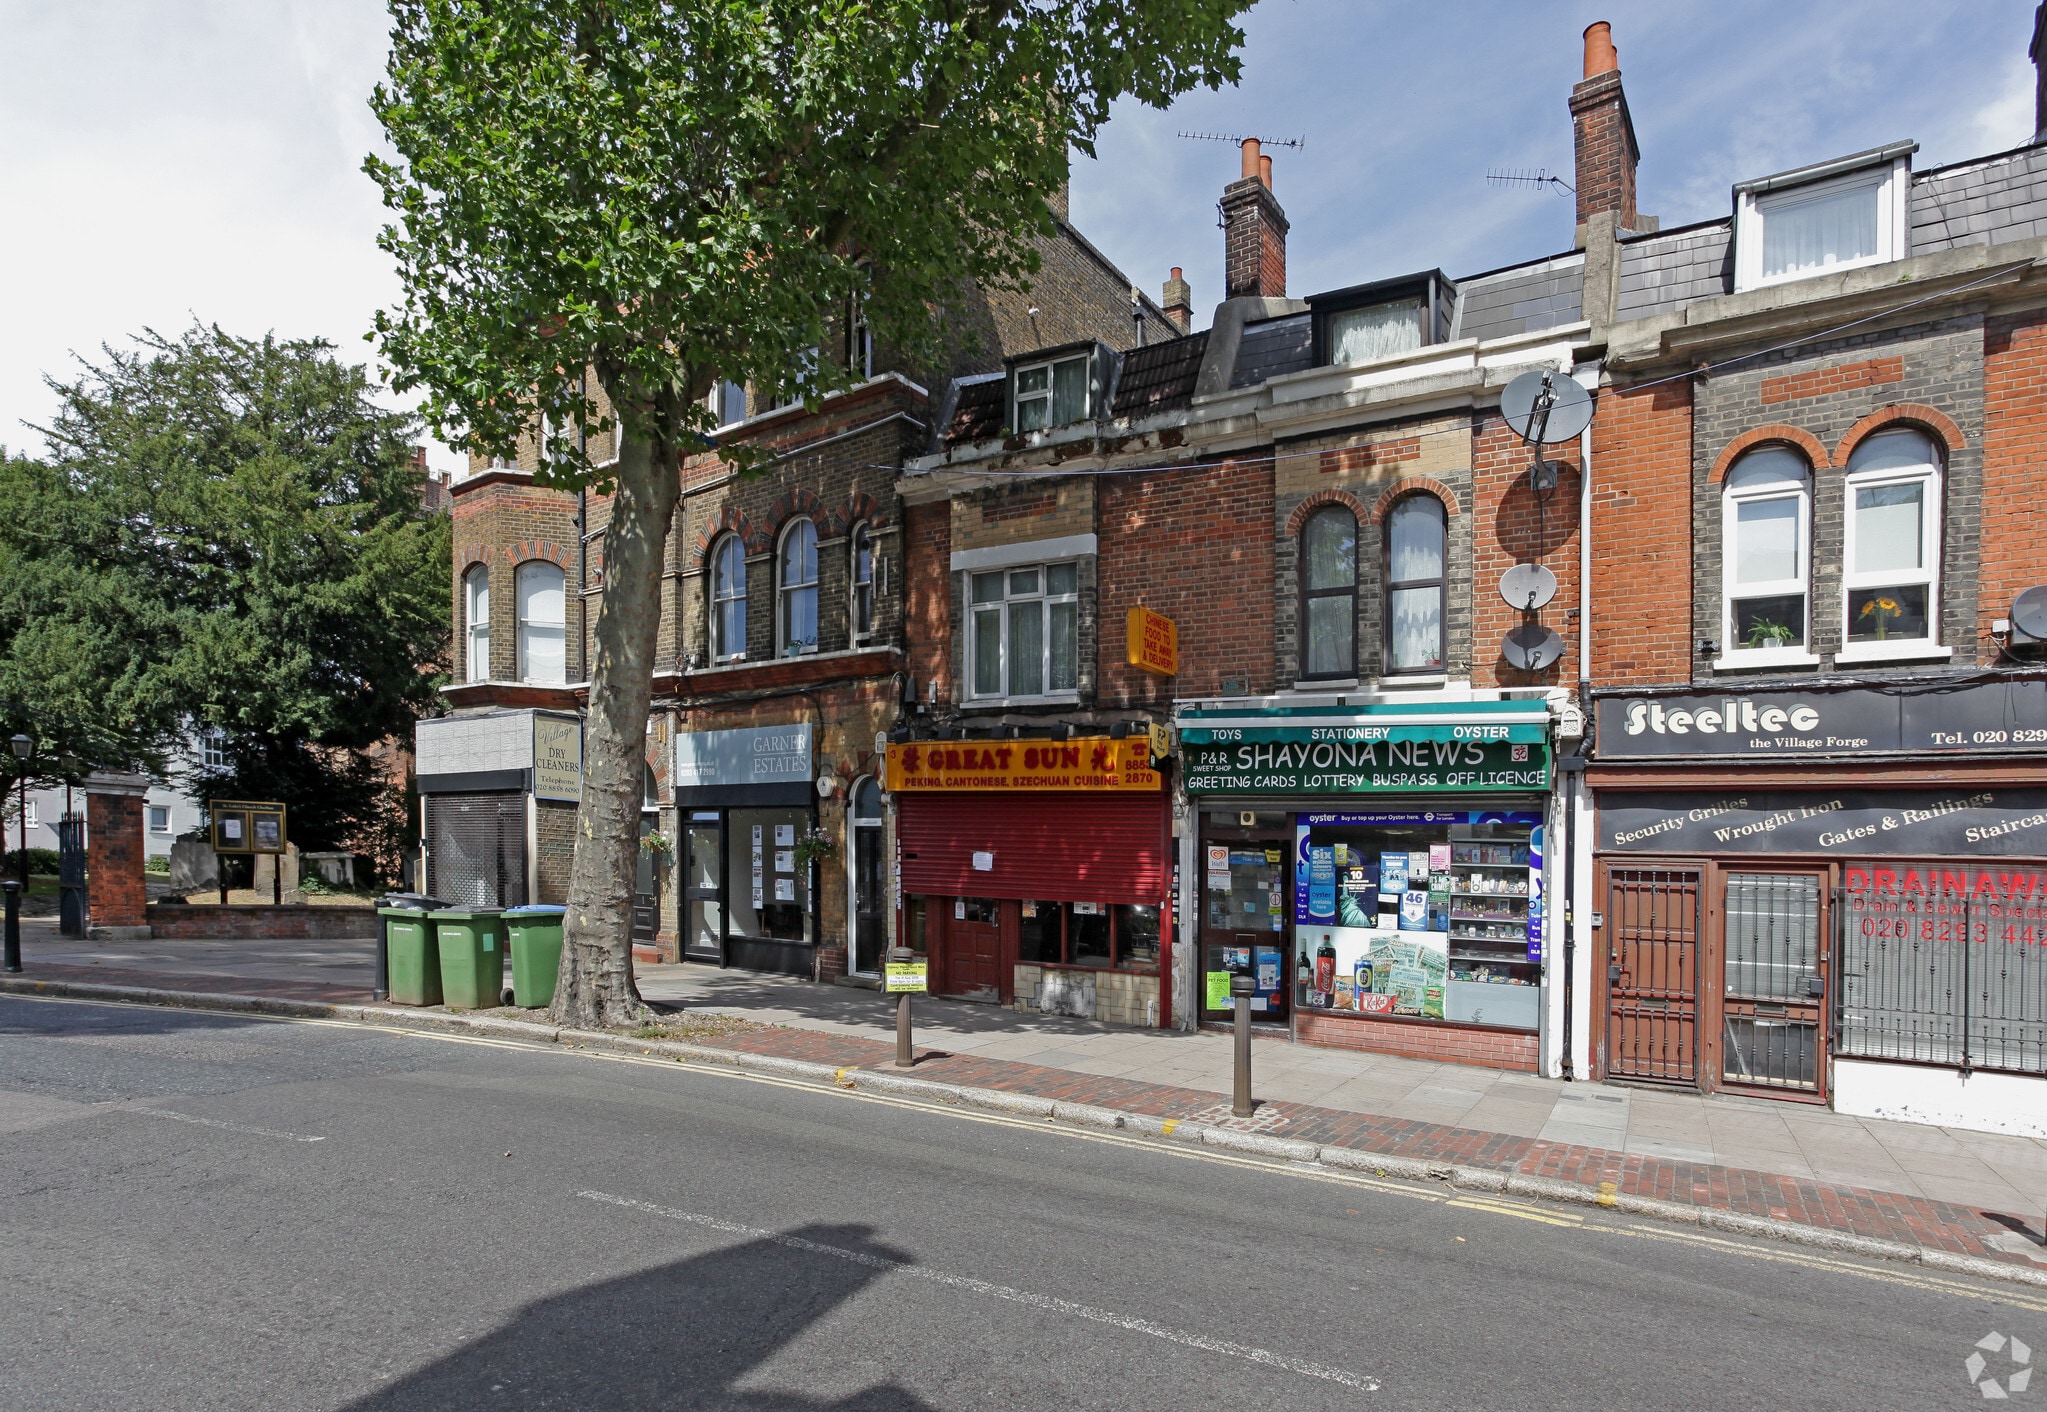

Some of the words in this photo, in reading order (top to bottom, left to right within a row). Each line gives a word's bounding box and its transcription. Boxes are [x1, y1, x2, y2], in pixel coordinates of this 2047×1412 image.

[1146, 614, 1169, 632] CHINESE
[1145, 626, 1161, 641] FOOD
[1164, 634, 1170, 645] TO
[1144, 638, 1157, 652] TAKE
[1159, 645, 1172, 658] AWAY
[1143, 650, 1147, 660] &
[1149, 653, 1173, 670] DELIVERY
[1624, 699, 1819, 736] Steeltec
[538, 724, 574, 744] Village
[1212, 730, 1242, 740] TOYS
[1312, 728, 1390, 739] STATIONERY
[1454, 727, 1509, 738] OYSTER
[1931, 732, 1967, 744] Tel.
[1973, 731, 2007, 743] 020
[2012, 729, 2047, 742] 829
[754, 735, 806, 752] GARNER
[1750, 738, 1771, 748] the
[1774, 737, 1822, 750] Village
[1826, 736, 1868, 748] Forge
[549, 748, 565, 758] DRY
[891, 750, 896, 759] 3
[928, 748, 1012, 770] GREAT
[1024, 747, 1079, 769] SUN
[1201, 752, 1208, 764] P
[1209, 752, 1217, 764] &
[1220, 752, 1228, 764] R
[1236, 743, 1377, 770] SHAYONA
[1388, 740, 1484, 767] NEWS
[536, 759, 579, 772] CLEANERS
[754, 756, 807, 773] ESTATES
[541, 776, 575, 785] Telephone
[1013, 776, 1069, 786] SZECHUAN
[1074, 775, 1119, 785] CUISINE
[1125, 773, 1152, 783] 2870
[1188, 776, 1251, 789] GREETING
[1254, 775, 1297, 787] CARDS
[1304, 775, 1364, 787] LOTTERY
[1446, 772, 1475, 786] OFF
[1480, 770, 1546, 785] LICENCE
[1309, 814, 1336, 823] oyster
[1615, 816, 1684, 846] Security
[1688, 797, 1747, 823] Grilles
[1713, 809, 1796, 842] Wrought
[1800, 799, 1844, 819] Iron
[1818, 824, 1876, 847] Gates
[1881, 816, 1898, 831] &
[1901, 792, 1994, 826] Railings
[1965, 812, 2047, 843] Stairca
[1312, 849, 1332, 860] Six
[1351, 871, 1363, 880] 10
[1406, 893, 1423, 903] 46
[1853, 898, 1898, 912] Drain
[1906, 900, 1916, 912] &
[1925, 901, 1980, 915] Sewer
[1862, 917, 1909, 938] 020
[1921, 920, 1987, 942] 8293
